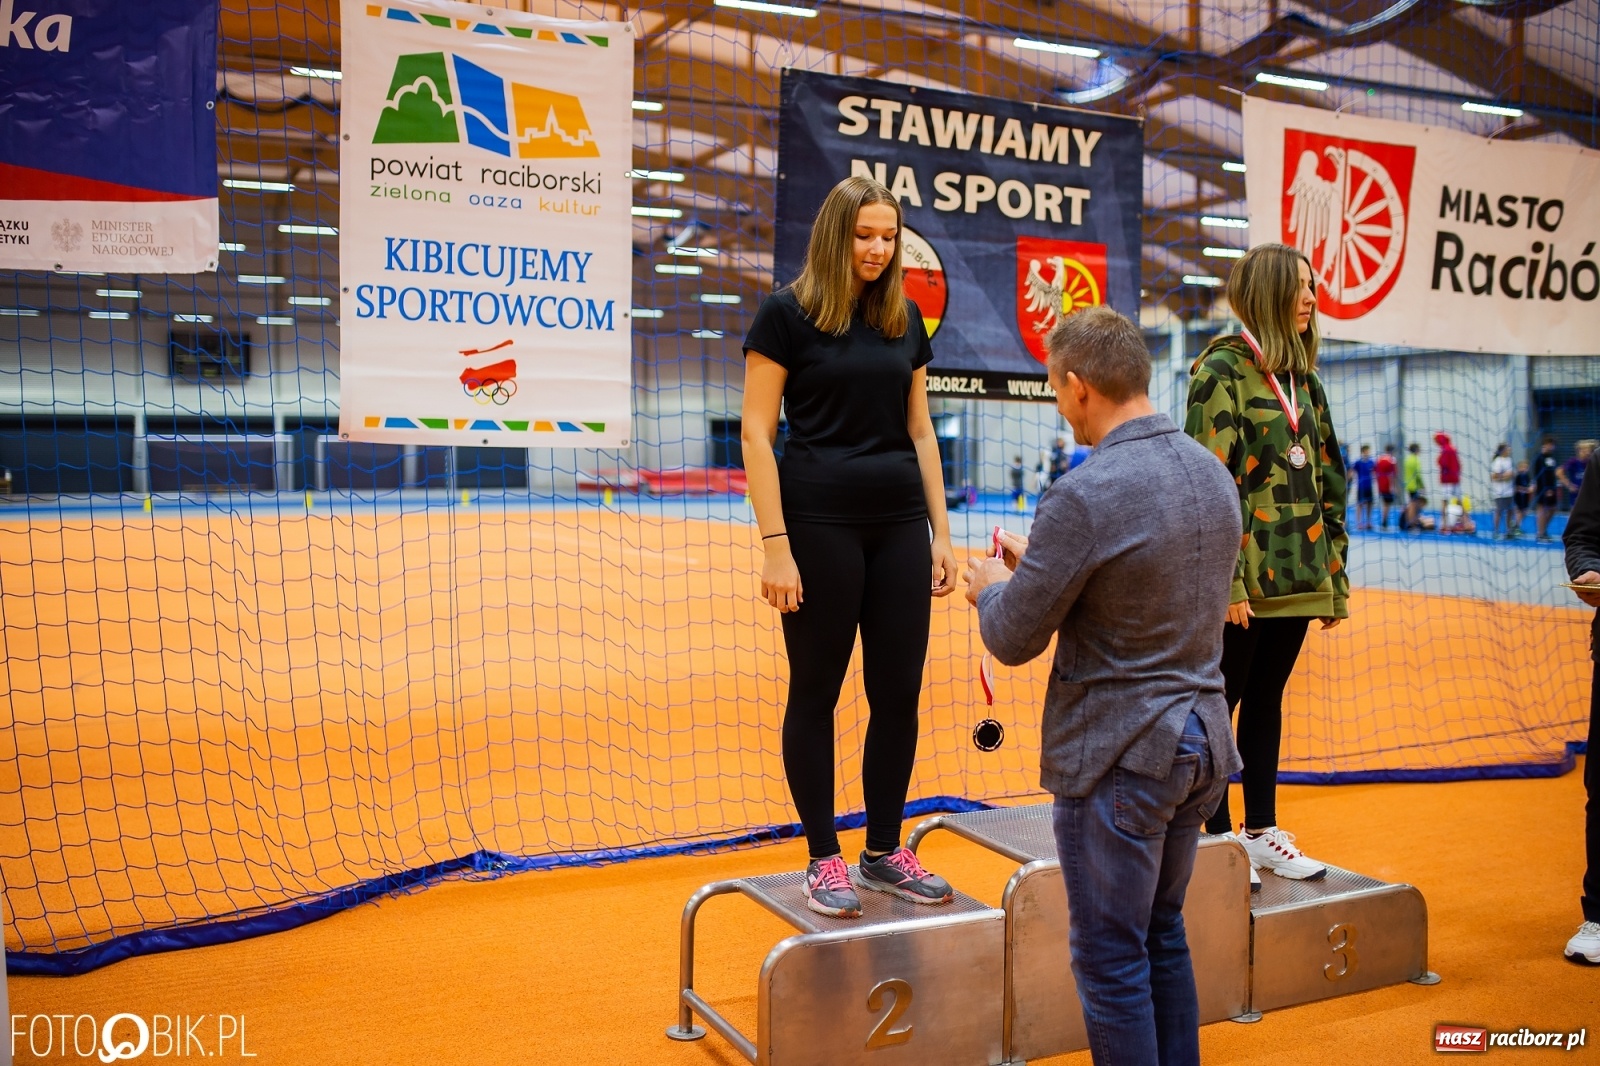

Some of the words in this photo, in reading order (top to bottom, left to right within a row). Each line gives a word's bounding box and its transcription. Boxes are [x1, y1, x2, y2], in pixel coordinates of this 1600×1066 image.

[837, 95, 1102, 168] STAWIAMY
[370, 156, 463, 182] powiat
[481, 165, 601, 194] raciborski
[933, 171, 1091, 225] SPORT
[370, 184, 451, 203] zielona
[468, 194, 523, 209] oaza
[539, 197, 602, 216] kultur
[1438, 184, 1564, 233] MIASTO
[91, 219, 153, 232] MINISTER
[92, 232, 154, 244] EDUKACJI
[92, 245, 174, 257] NARODOWEJ
[384, 236, 593, 286] KIBICUJEMY
[1431, 230, 1600, 302] Racibó
[356, 284, 615, 331] SPORTOWCOM
[1324, 923, 1358, 982] 3
[864, 978, 913, 1052] 2
